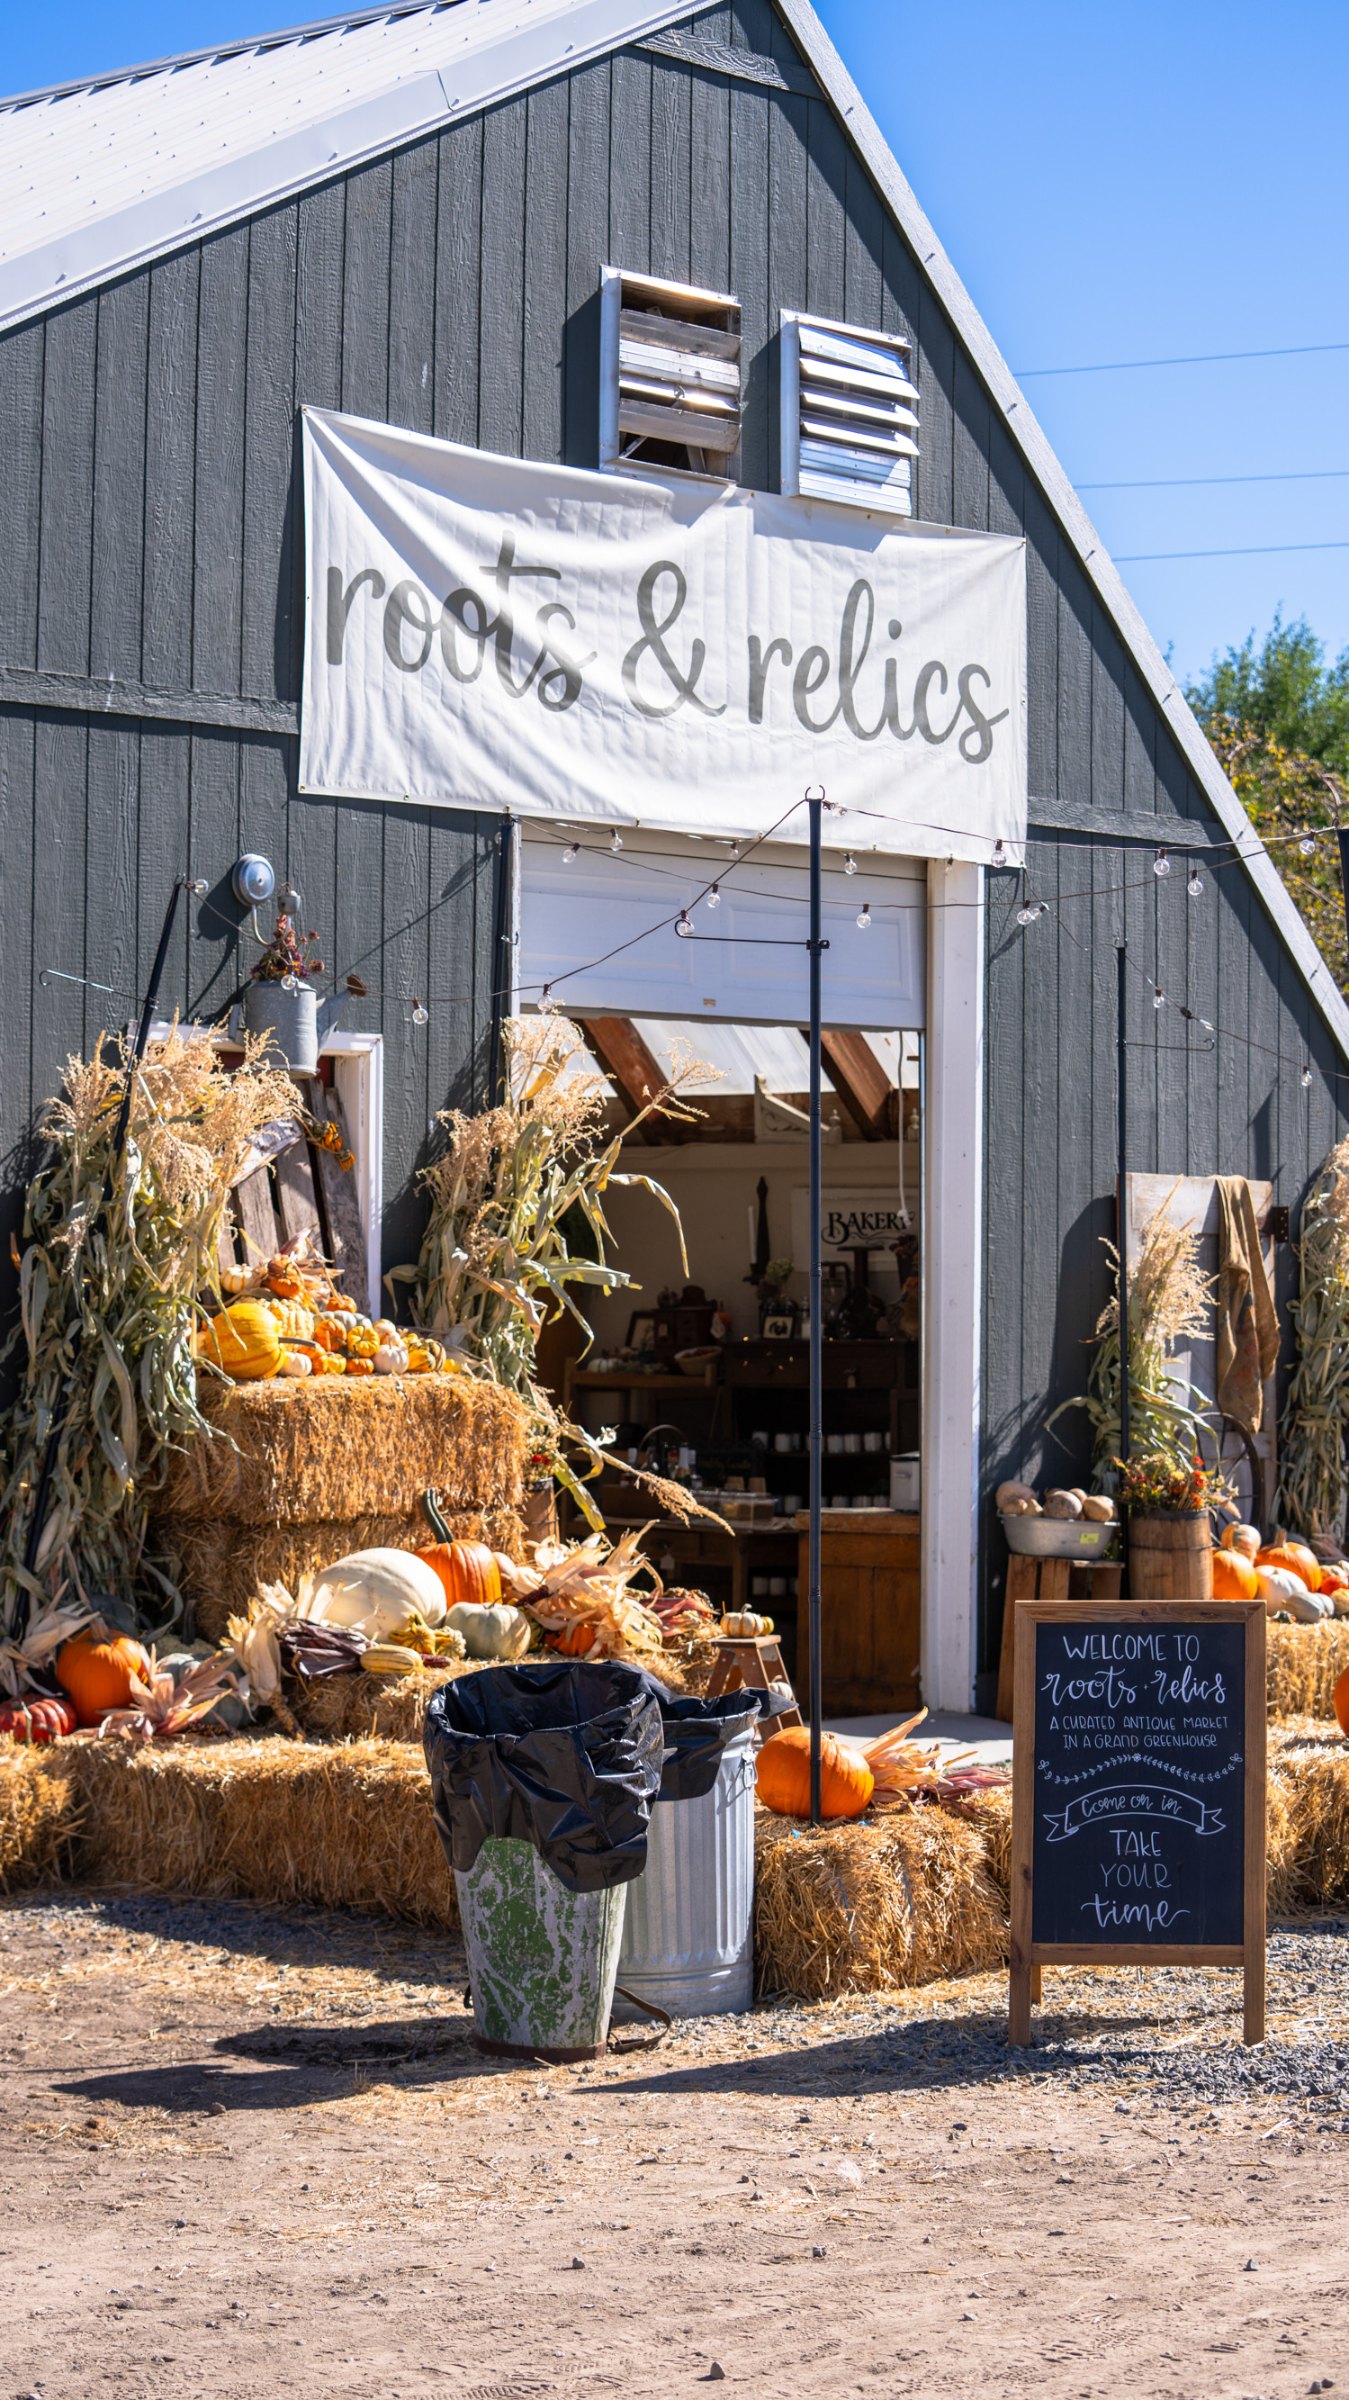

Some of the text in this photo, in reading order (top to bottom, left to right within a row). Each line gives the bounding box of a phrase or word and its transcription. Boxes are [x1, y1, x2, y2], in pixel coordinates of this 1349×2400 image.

[327, 529, 1010, 764] roots & relics
[1063, 1633, 1200, 1661] WELCOME TO
[1040, 1665, 1138, 1708] roots
[1150, 1665, 1226, 1705] relics
[1050, 1715, 1228, 1731] A CURATED ANTIQUE MARKET
[1063, 1735, 1078, 1749] IN
[1083, 1735, 1092, 1748] A
[1094, 1734, 1139, 1749] GRAND
[1161, 1794, 1182, 1814] in
[1109, 1829, 1162, 1857] TAKE
[1100, 1863, 1172, 1889] YOUR
[1080, 1893, 1191, 1932] time
